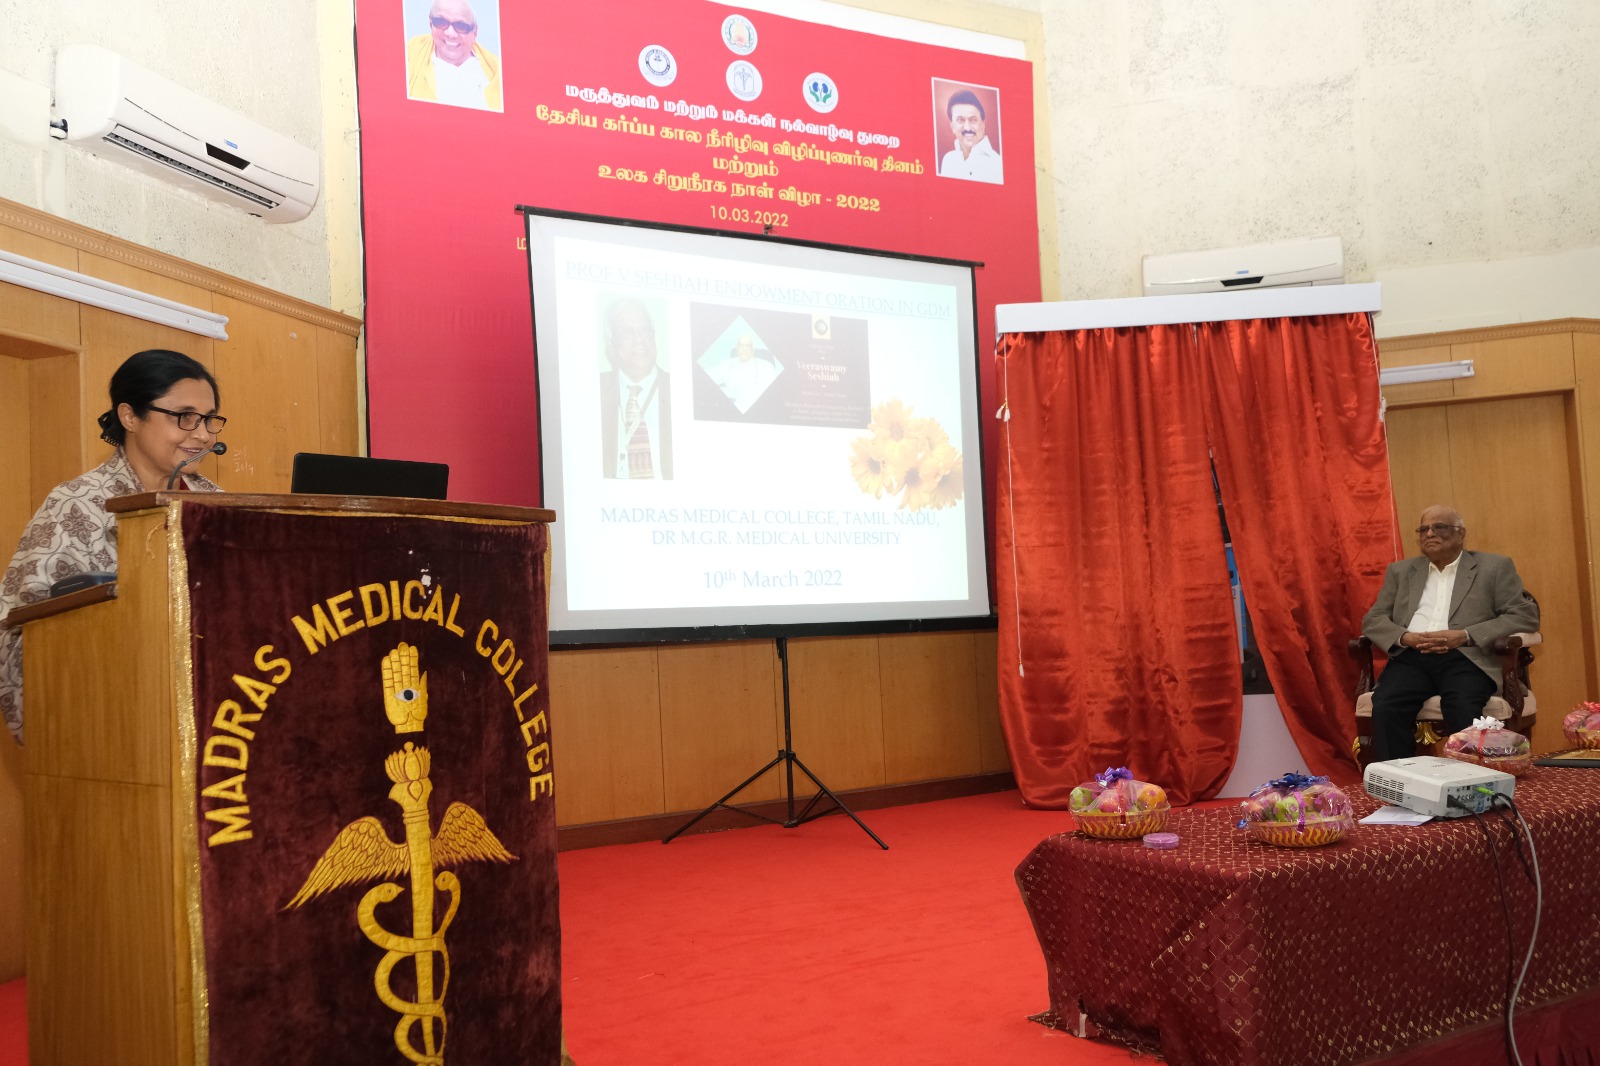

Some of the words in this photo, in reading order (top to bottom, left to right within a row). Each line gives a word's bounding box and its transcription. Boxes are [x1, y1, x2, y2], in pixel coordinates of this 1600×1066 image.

[565, 84, 660, 110] மருத்துவம்
[663, 99, 718, 120] மற்றும்
[722, 109, 776, 128] மக்கள்
[780, 118, 854, 142] நல்வாழ்வு
[857, 131, 900, 149] துறை
[536, 104, 598, 129] தேசிய
[602, 114, 655, 137] கர்ப்ப
[659, 126, 702, 143] கால
[706, 128, 769, 154] நீரிழிவு
[773, 140, 878, 171] விழிப்புணர்வு
[881, 156, 924, 175] தினம்
[713, 155, 779, 178] மற்றும்
[598, 165, 648, 183] உலக
[653, 169, 727, 193] சிறுநீரக
[731, 182, 774, 199] நாள்
[778, 186, 821, 207] விழா
[836, 194, 880, 212] 2022
[710, 205, 789, 227] 10.03.2022
[565, 260, 613, 281] PROF
[617, 267, 630, 283] V
[635, 270, 710, 293] SESHIAH
[715, 279, 822, 303] ENDOWMENT
[825, 292, 895, 312] ORATION
[898, 301, 914, 314] IN
[916, 303, 951, 318] GDM
[600, 507, 679, 523] MADRAS
[683, 509, 760, 524] MEDICAL
[764, 510, 839, 526] COLLEGE,
[843, 512, 890, 525] TAMIL
[893, 512, 941, 527] NADU,
[652, 530, 676, 545] DR
[681, 531, 732, 545] M.G.R.
[737, 531, 810, 545] MEDICAL
[814, 531, 902, 545] UNIVERSITY
[703, 568, 737, 588] 10th
[742, 569, 799, 588] March
[804, 569, 843, 587] 2022
[201, 644, 292, 848] MADRAS
[291, 579, 465, 655] MEDICAL
[475, 618, 554, 802] COLLEGE
